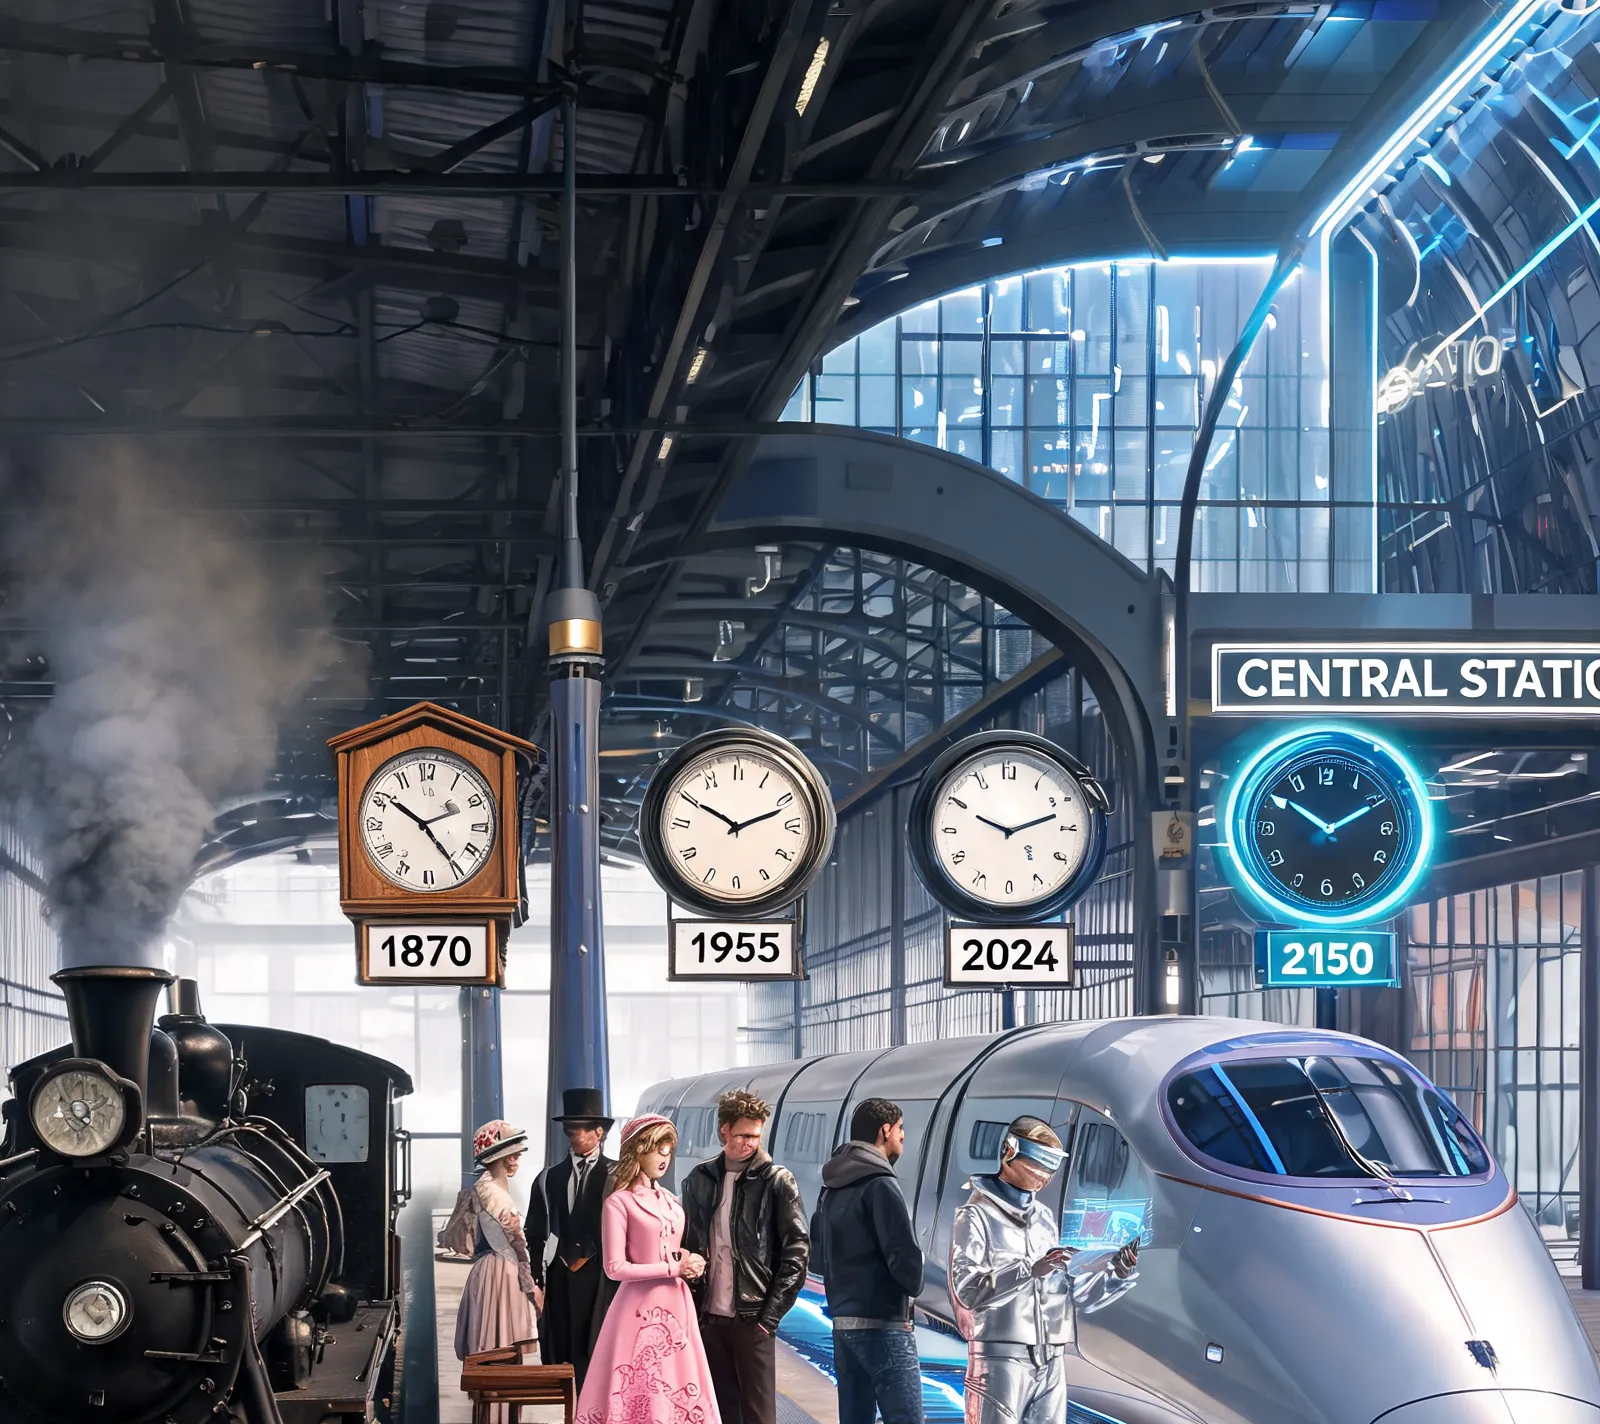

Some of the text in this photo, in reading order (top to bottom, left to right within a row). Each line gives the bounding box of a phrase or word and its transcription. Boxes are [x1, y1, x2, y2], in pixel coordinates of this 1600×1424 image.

[1237, 658, 1448, 698] CENTRAL
[381, 934, 471, 968] 1870
[691, 931, 780, 964] 1955
[962, 938, 1059, 972] 2024
[1281, 941, 1374, 976] 2150
